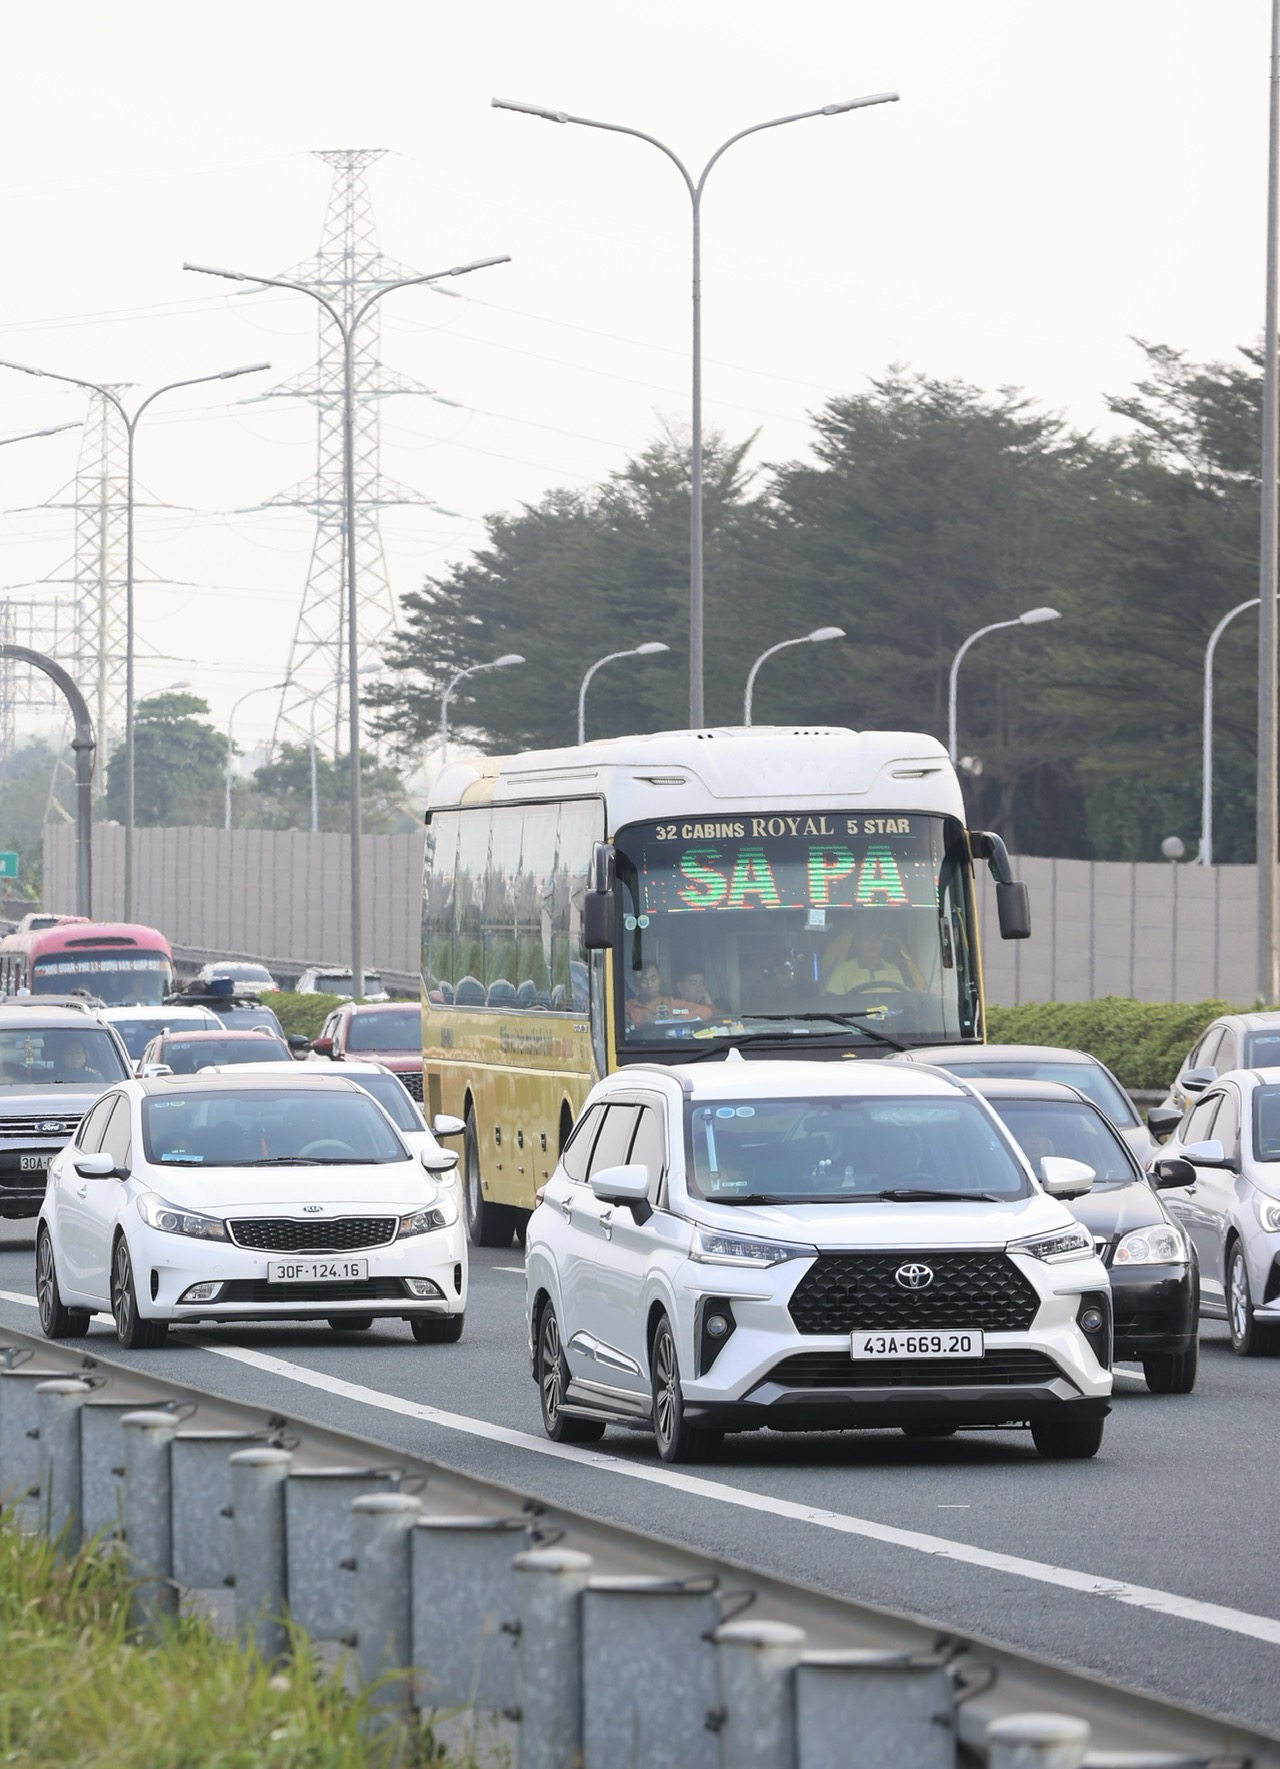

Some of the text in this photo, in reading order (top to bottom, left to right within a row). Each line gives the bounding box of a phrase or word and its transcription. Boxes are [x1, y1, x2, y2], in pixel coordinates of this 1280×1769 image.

[656, 816, 910, 840] 32 CABINS ROYAL 5 STAR
[678, 844, 908, 907] SA PA
[277, 1264, 359, 1278] 30F-124.16
[863, 1336, 971, 1354] 43A-669.20
